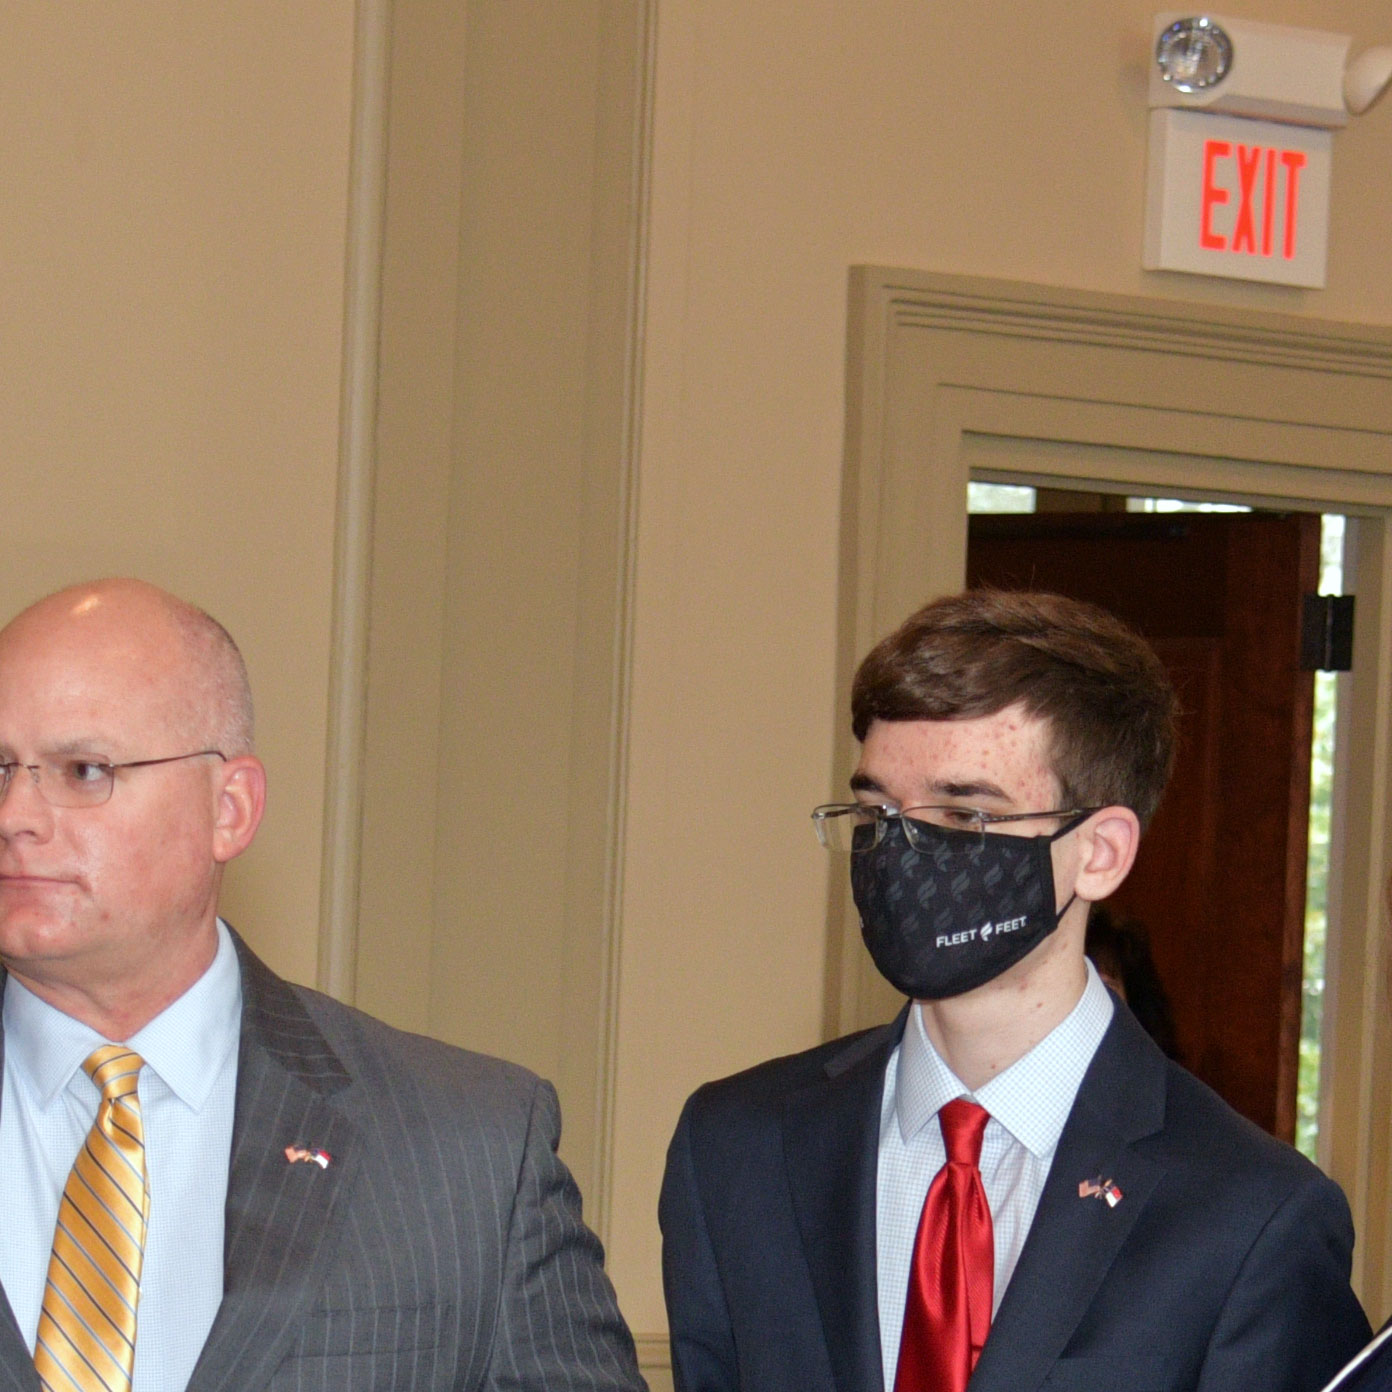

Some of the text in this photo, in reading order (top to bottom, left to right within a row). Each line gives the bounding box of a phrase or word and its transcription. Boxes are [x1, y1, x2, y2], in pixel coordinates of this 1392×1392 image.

[1200, 140, 1307, 260] EXIT
[936, 915, 1027, 948] FLEET FEET
